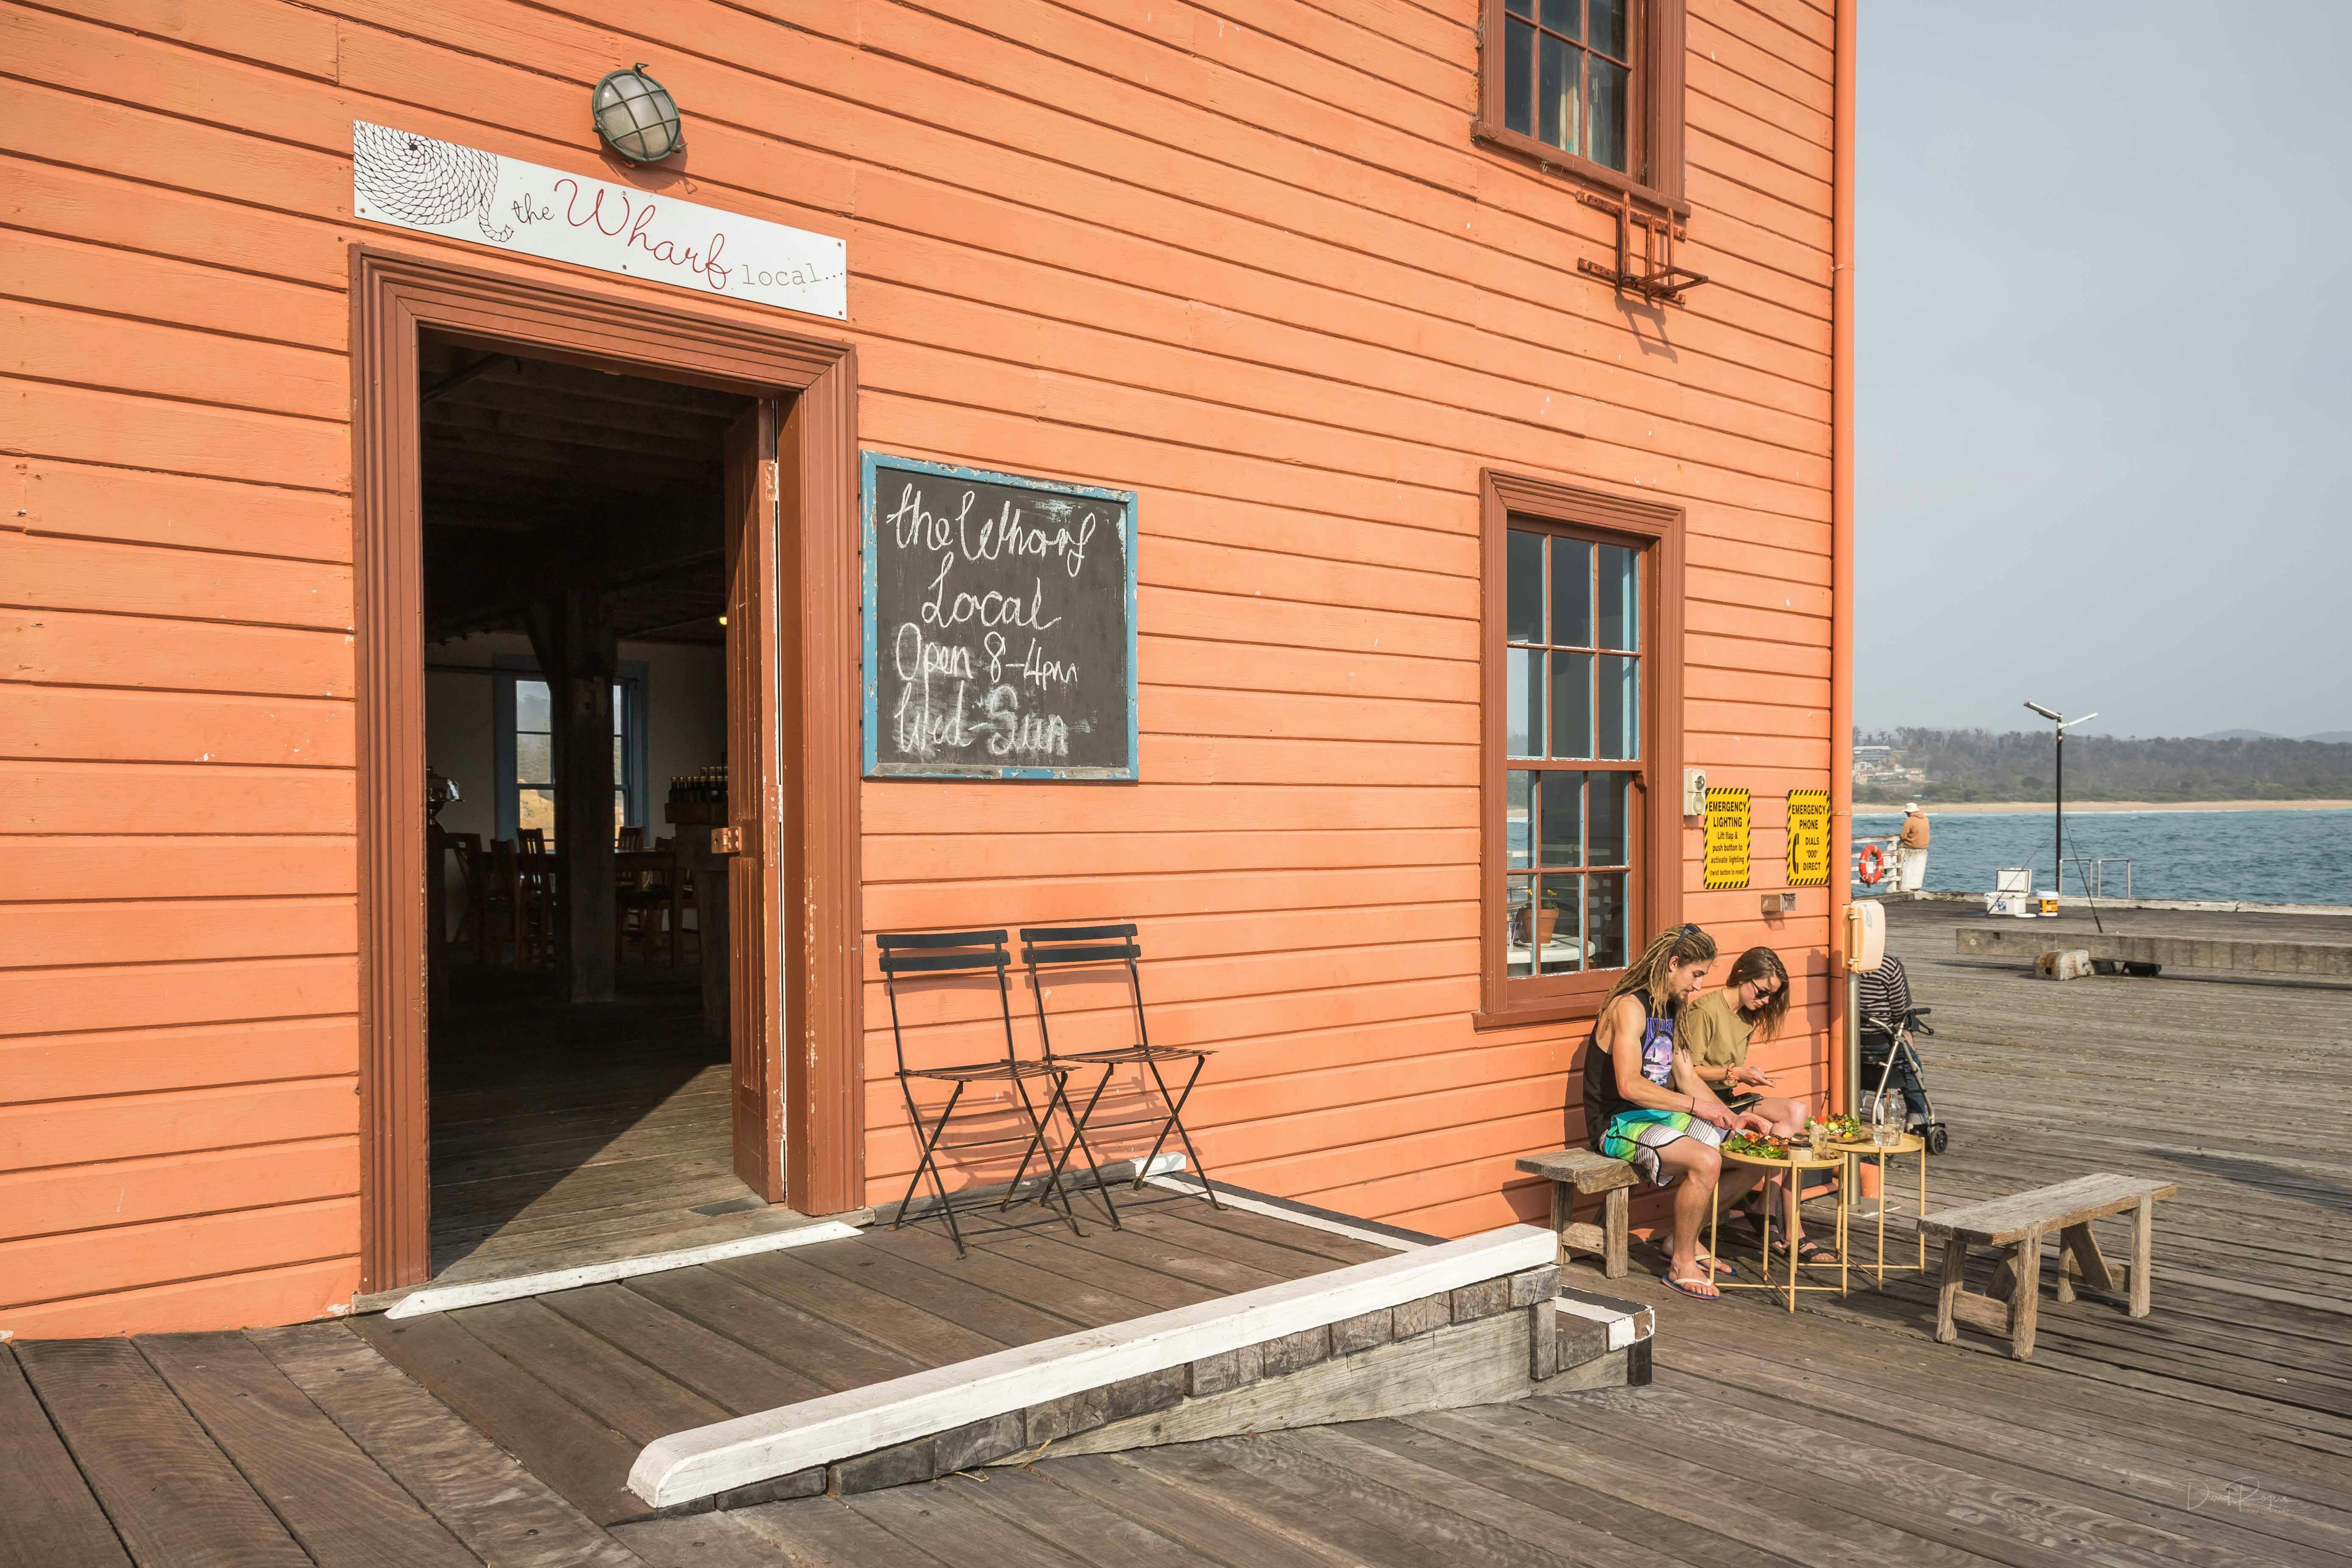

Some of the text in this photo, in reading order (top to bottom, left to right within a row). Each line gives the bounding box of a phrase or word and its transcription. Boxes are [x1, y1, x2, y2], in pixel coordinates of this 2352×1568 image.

[511, 193, 555, 225] the
[554, 179, 733, 290] Wharf
[886, 482, 1096, 577] the Wharf
[921, 551, 1062, 631] Local
[896, 622, 974, 697] Open
[1709, 801, 1747, 812] EMERGENCY
[1792, 804, 1826, 815] EMERGENCY
[1713, 816, 1742, 827] LIGHTING
[1799, 819, 1818, 830] PHONE
[1725, 831, 1733, 841] flap
[1735, 831, 1738, 839] &
[1805, 837, 1820, 845] DIALS
[1712, 844, 1722, 854] push
[1711, 855, 1744, 865] activate lighting
[1803, 862, 1821, 871] DIRECT
